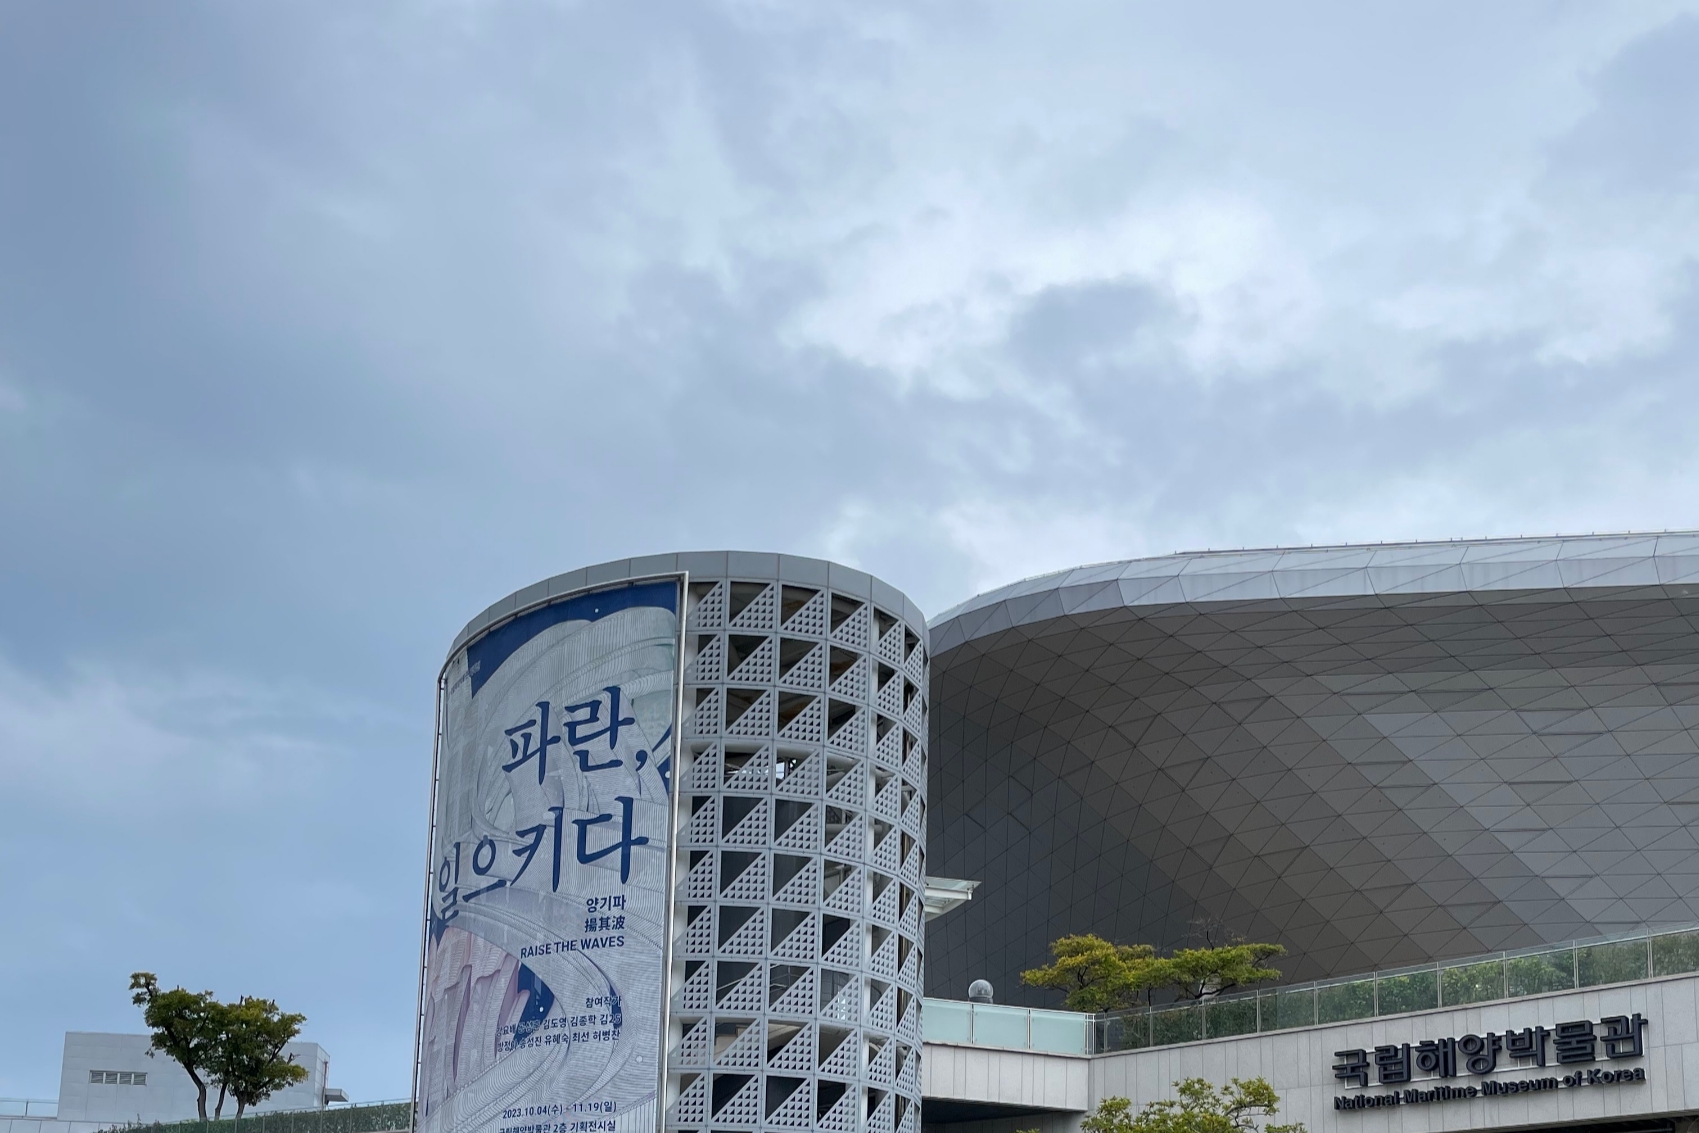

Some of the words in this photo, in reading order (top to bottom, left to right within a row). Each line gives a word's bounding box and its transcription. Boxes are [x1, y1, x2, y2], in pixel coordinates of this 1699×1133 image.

[502, 686, 648, 785] 파란,
[438, 796, 649, 924] 일으키다
[586, 894, 626, 913] 양기파
[584, 915, 626, 933] 揚其波
[520, 943, 552, 959] RAISE
[553, 939, 577, 953] THE
[580, 935, 625, 950] WAVES
[585, 995, 621, 1009] 참여작가
[543, 1017, 567, 1030] 김도영
[570, 1014, 596, 1027] 김종학
[544, 1033, 569, 1046] 유혜숙
[572, 1031, 590, 1043] 최선
[1332, 1012, 1648, 1087] 국립해양박물관
[1333, 1091, 1400, 1111] National
[1403, 1085, 1477, 1105] Maritime
[1481, 1076, 1558, 1097] Museum
[1563, 1070, 1583, 1088] of
[1586, 1065, 1646, 1084] Korea
[572, 1101, 617, 1113] 11.19(일)
[553, 1123, 567, 1133] 2층
[570, 1120, 616, 1133] 기획전시실
